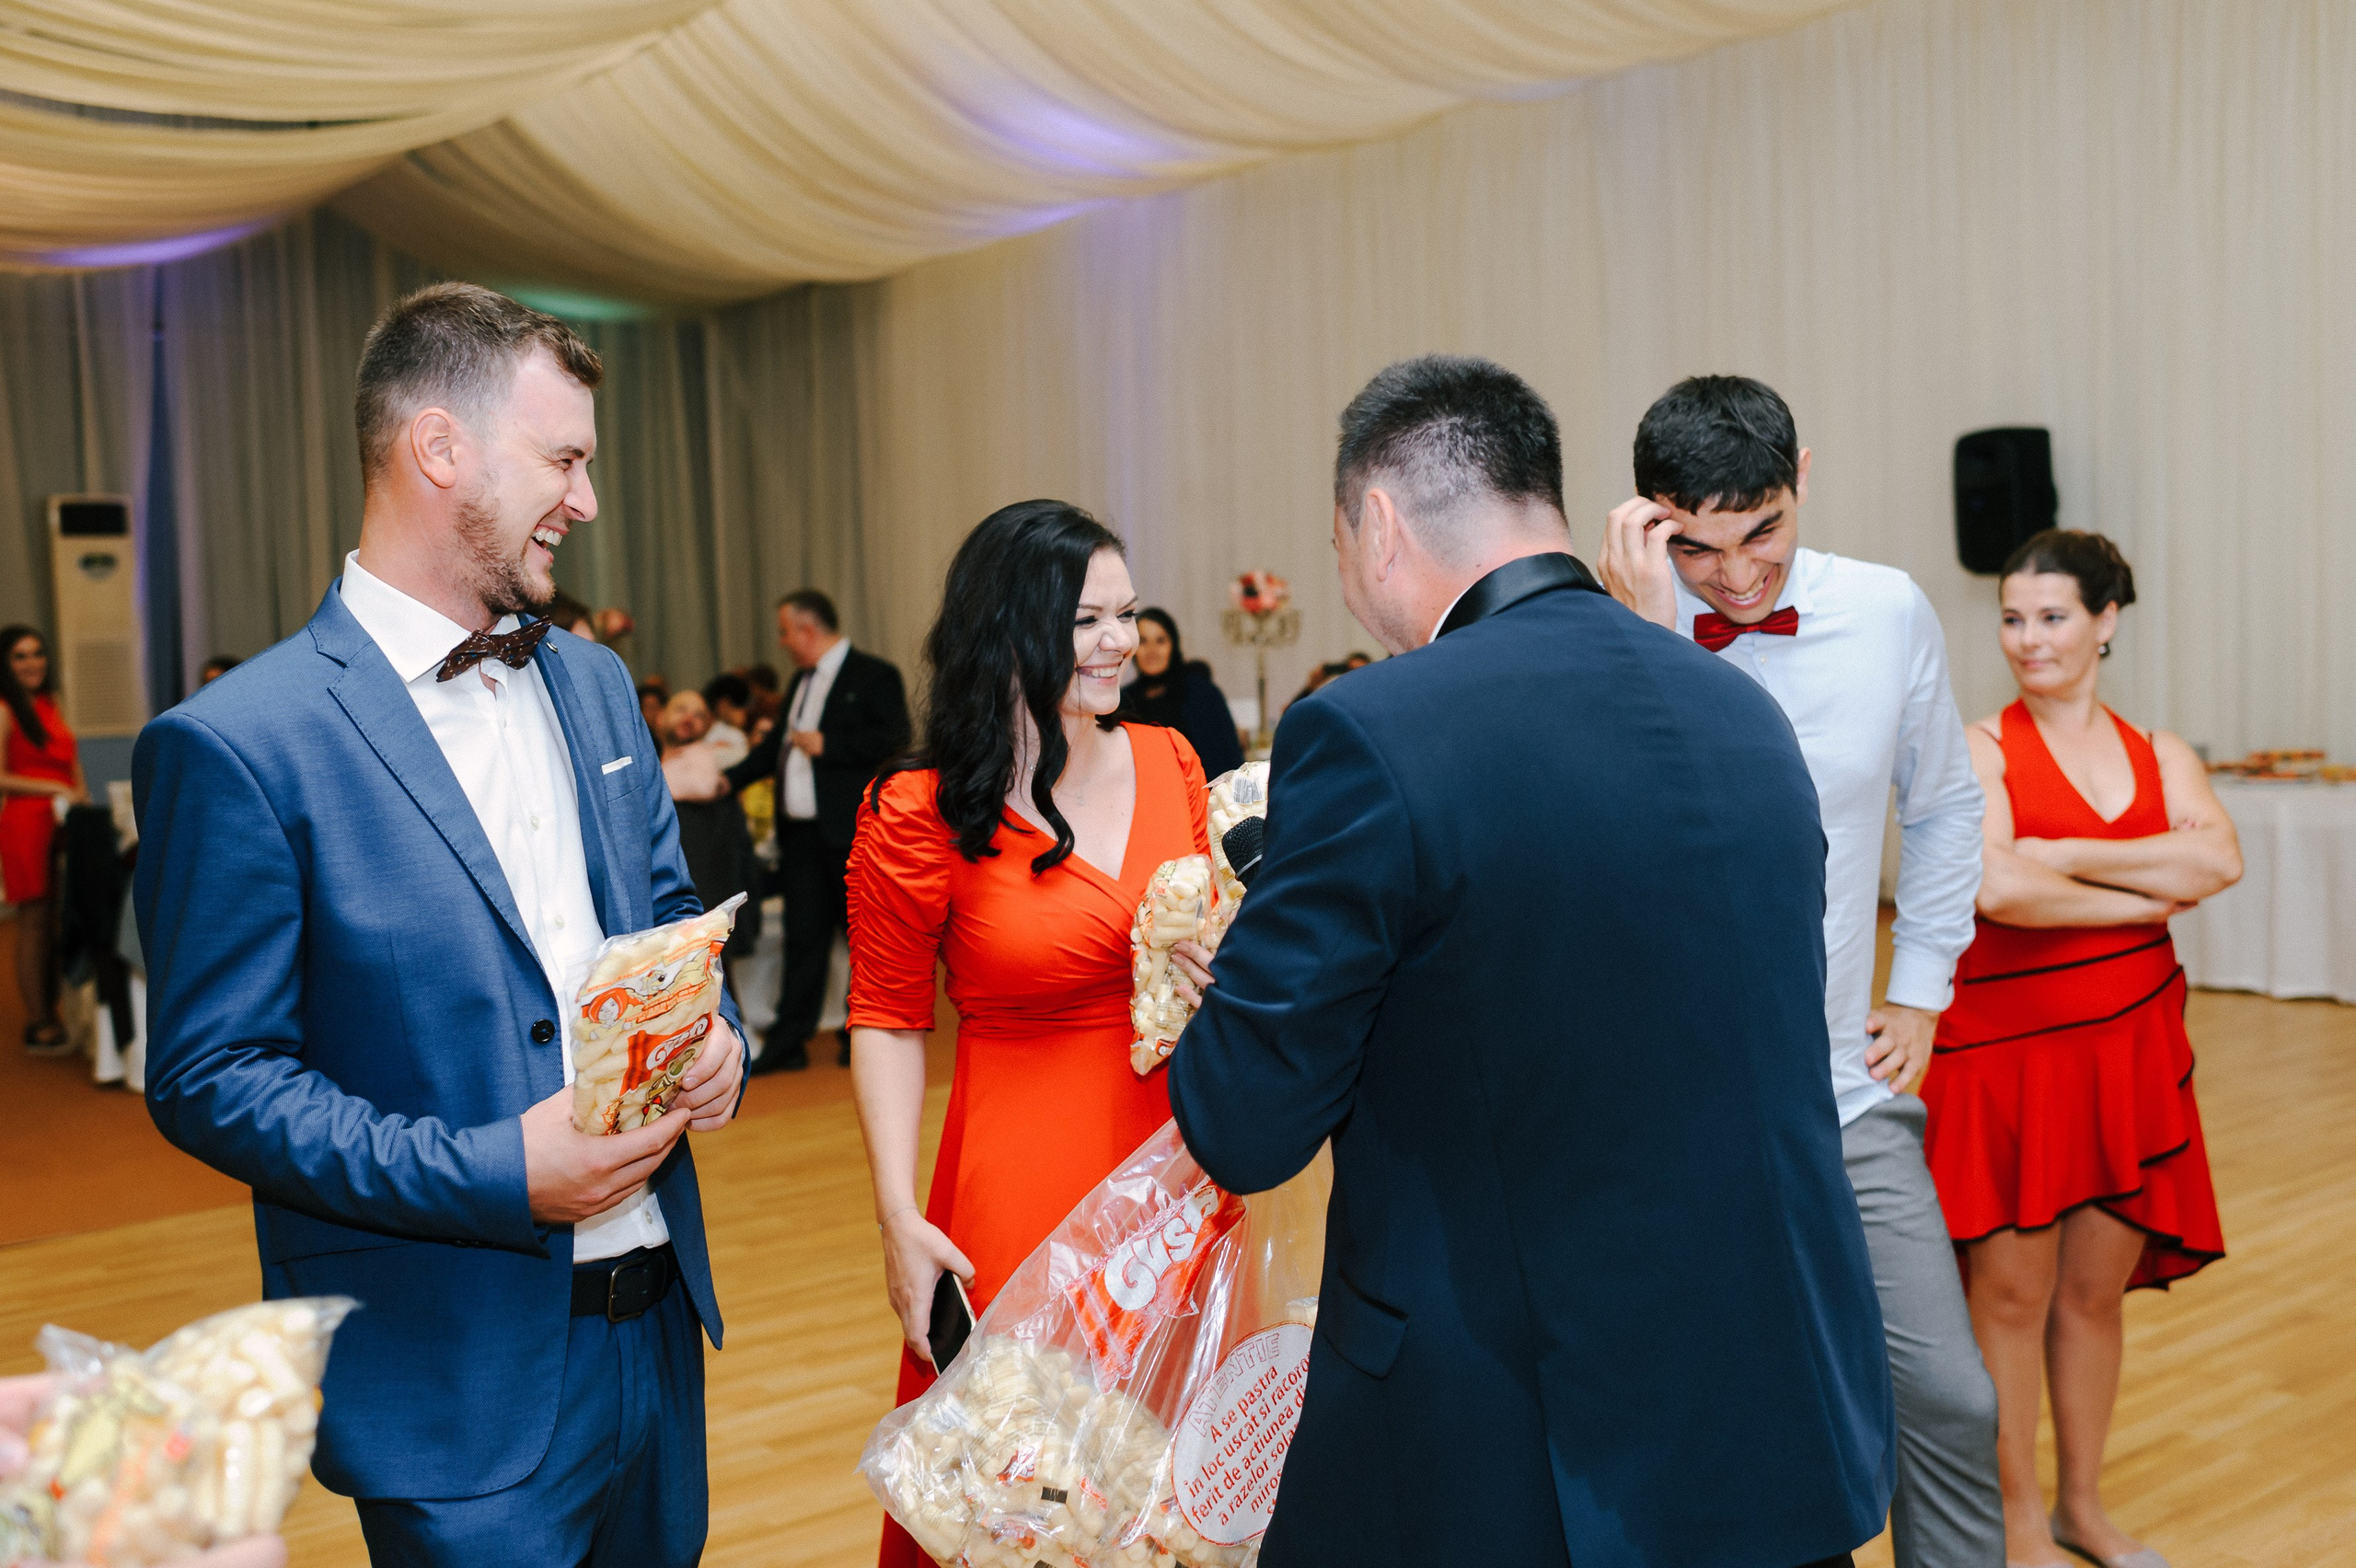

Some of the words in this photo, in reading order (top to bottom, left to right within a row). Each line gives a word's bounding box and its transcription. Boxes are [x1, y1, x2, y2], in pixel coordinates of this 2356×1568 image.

[1188, 1332, 1280, 1437] ATENTIE
[1210, 1424, 1223, 1443] A
[1221, 1409, 1238, 1430] se
[1237, 1365, 1278, 1418] pastra
[1191, 1484, 1224, 1525] ferit
[1223, 1469, 1242, 1491] de
[1242, 1404, 1294, 1470] actiunea
[1201, 1453, 1225, 1481] loc
[1223, 1413, 1260, 1458] uscat
[1258, 1398, 1271, 1421] si
[1218, 1511, 1230, 1527] a
[1229, 1458, 1269, 1514] razelor
